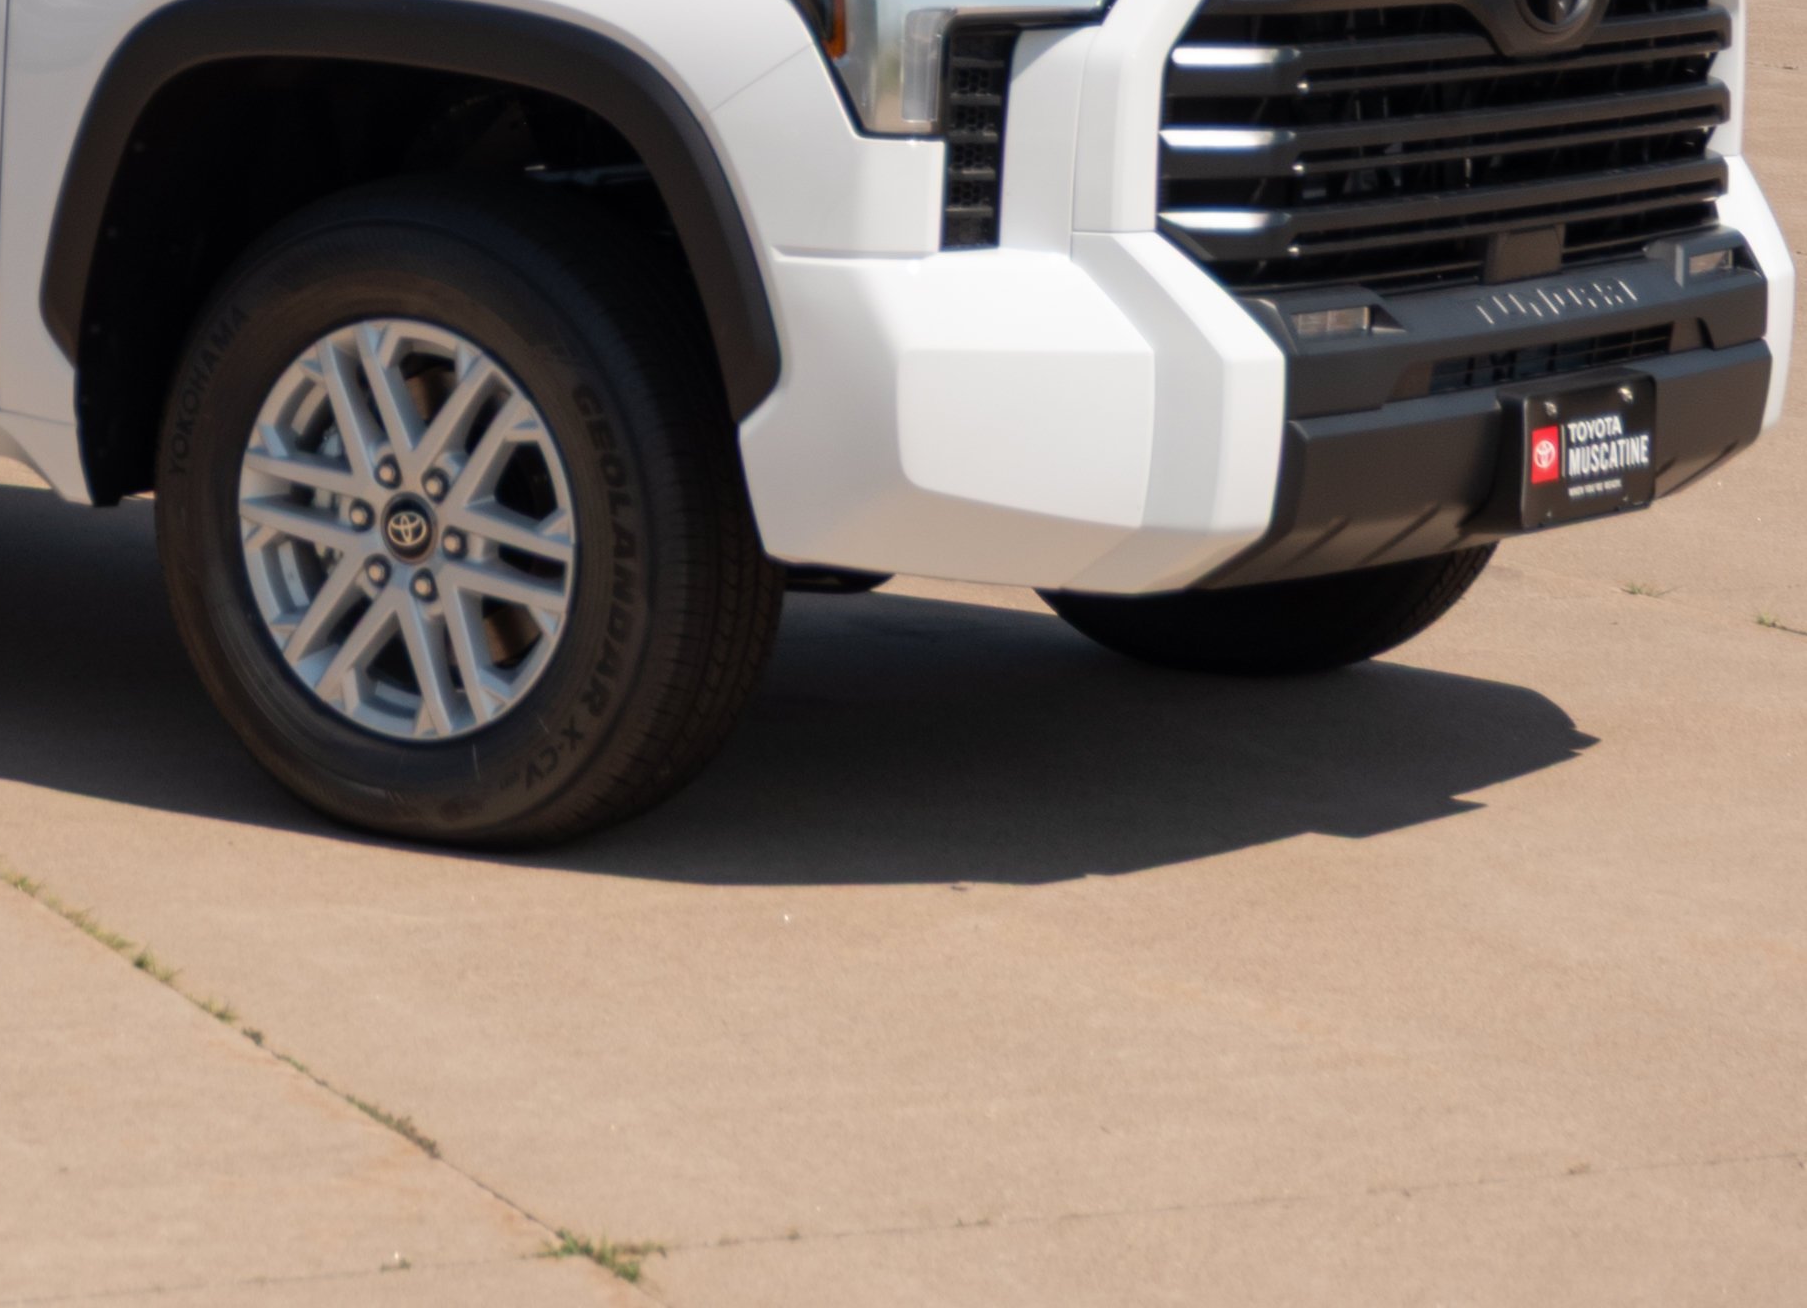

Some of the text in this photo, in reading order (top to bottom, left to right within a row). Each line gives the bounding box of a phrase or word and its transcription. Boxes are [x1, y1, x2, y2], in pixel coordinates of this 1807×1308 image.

[168, 306, 250, 475] YOKOHAMA
[1568, 415, 1623, 443] TOYOTA
[1568, 434, 1650, 477] MUSCATINE
[571, 382, 642, 720] GEOLANDAR
